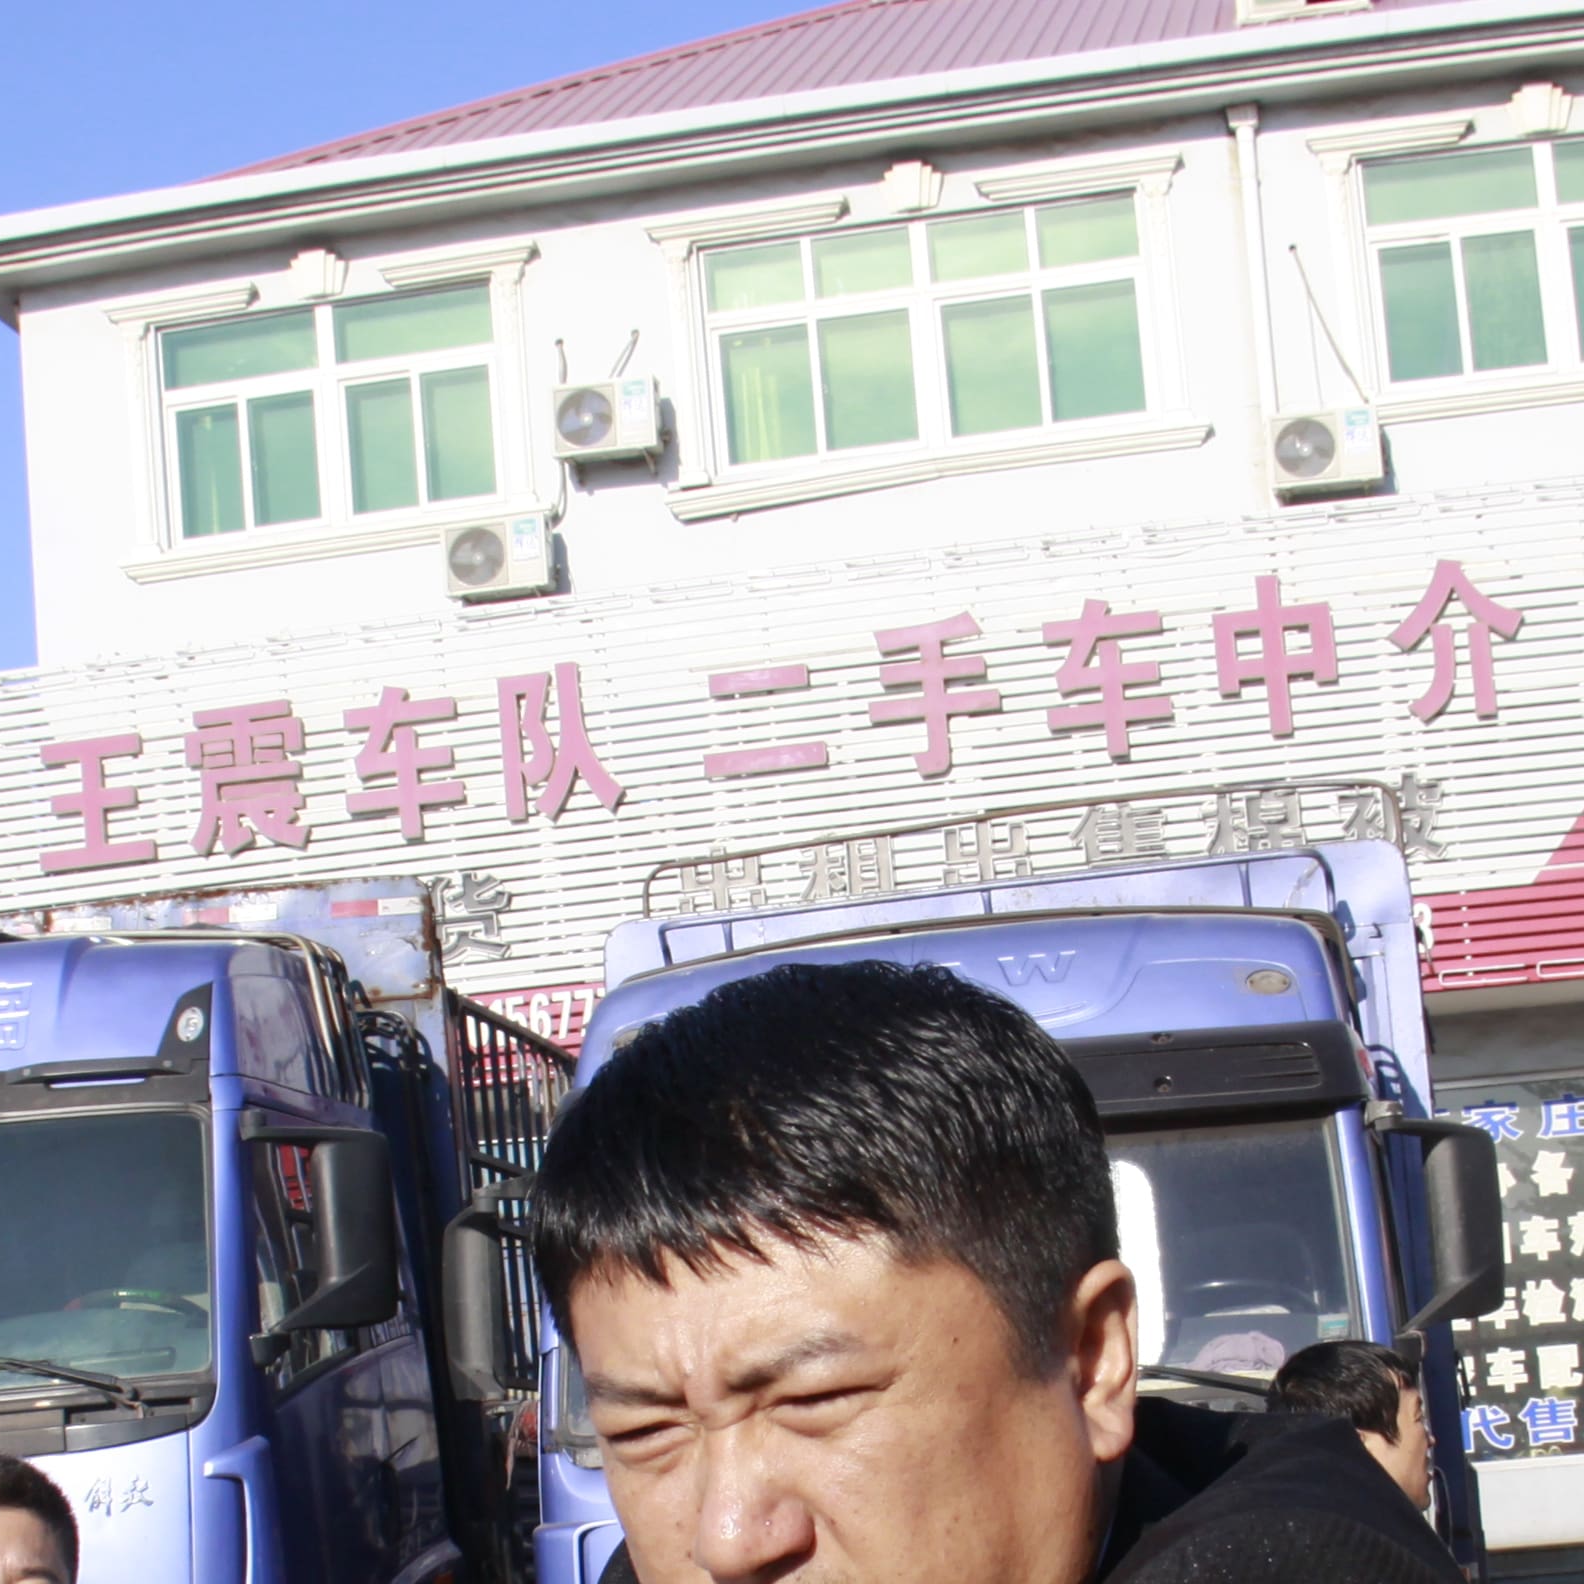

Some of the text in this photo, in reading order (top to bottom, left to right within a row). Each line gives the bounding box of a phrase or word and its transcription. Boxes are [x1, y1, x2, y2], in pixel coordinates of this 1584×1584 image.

[38, 559, 1524, 877] 王震车队 二手车中介
